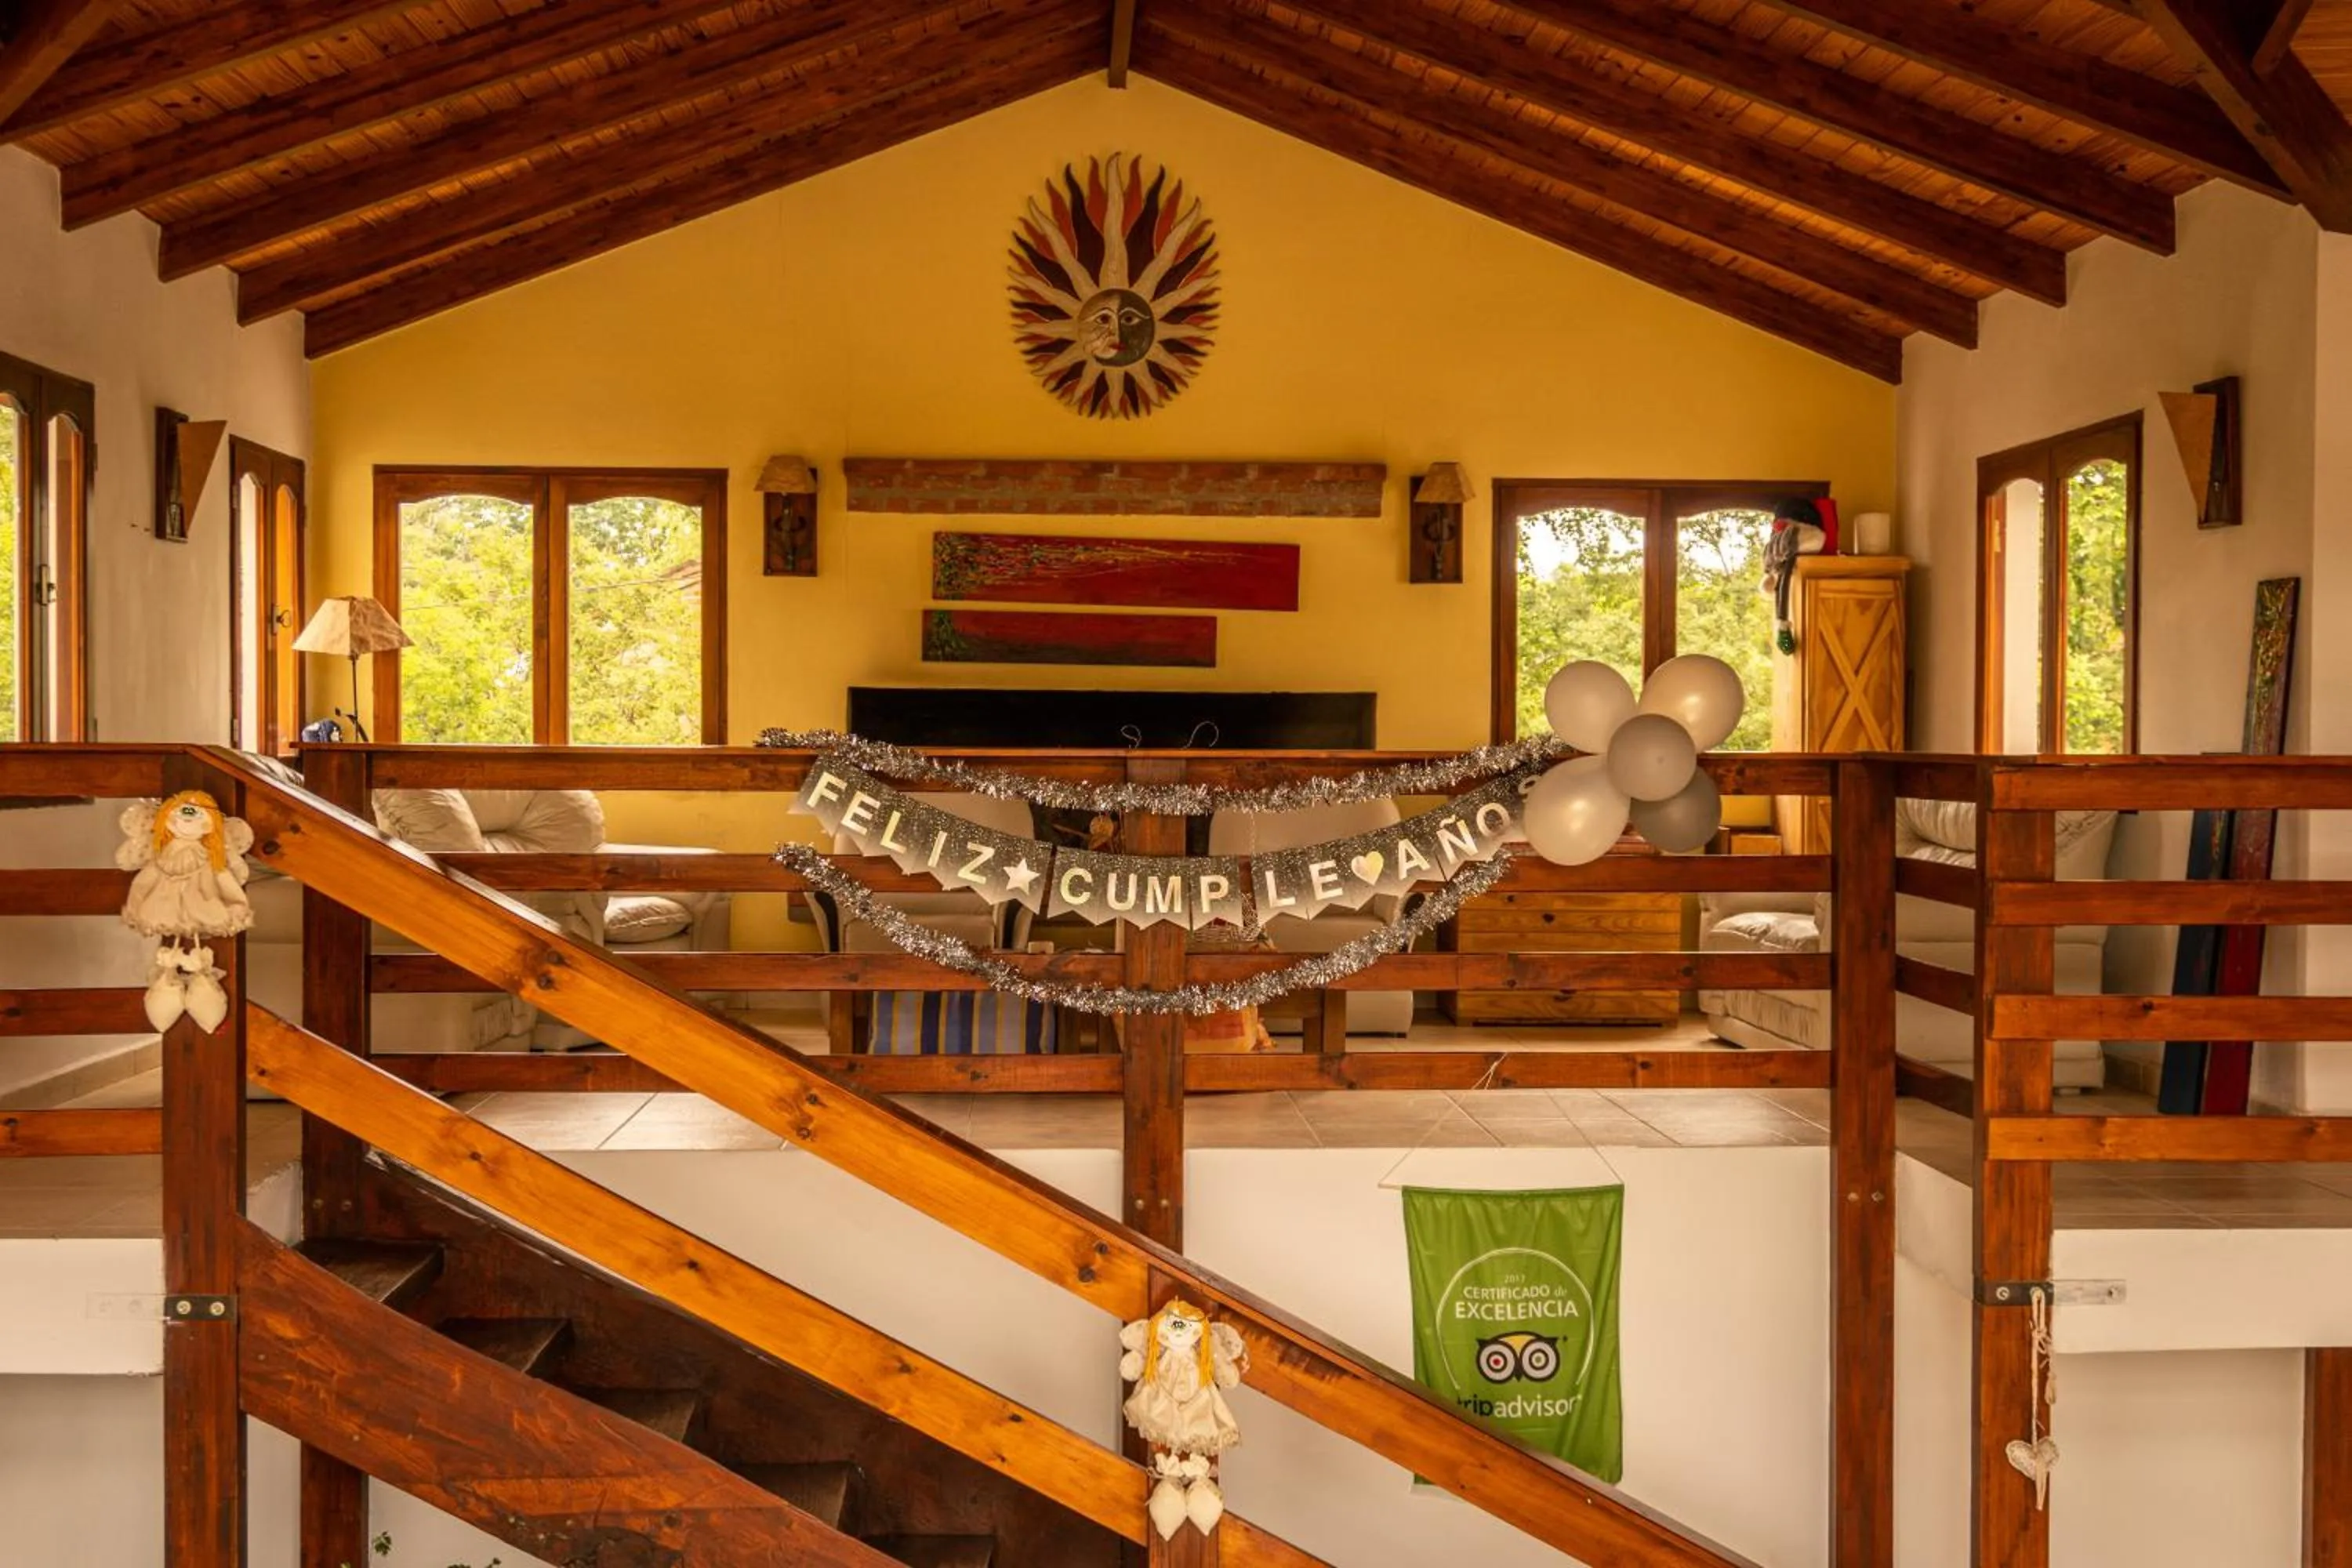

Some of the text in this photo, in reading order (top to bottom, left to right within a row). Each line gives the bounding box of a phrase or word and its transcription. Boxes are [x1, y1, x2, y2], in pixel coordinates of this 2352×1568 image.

[806, 771, 996, 884] FELIZ
[1060, 858, 1343, 914] CUMPLE
[1463, 1284, 1567, 1300] CERTIFICADO de
[1455, 1300, 1579, 1321] EXCELENCIA
